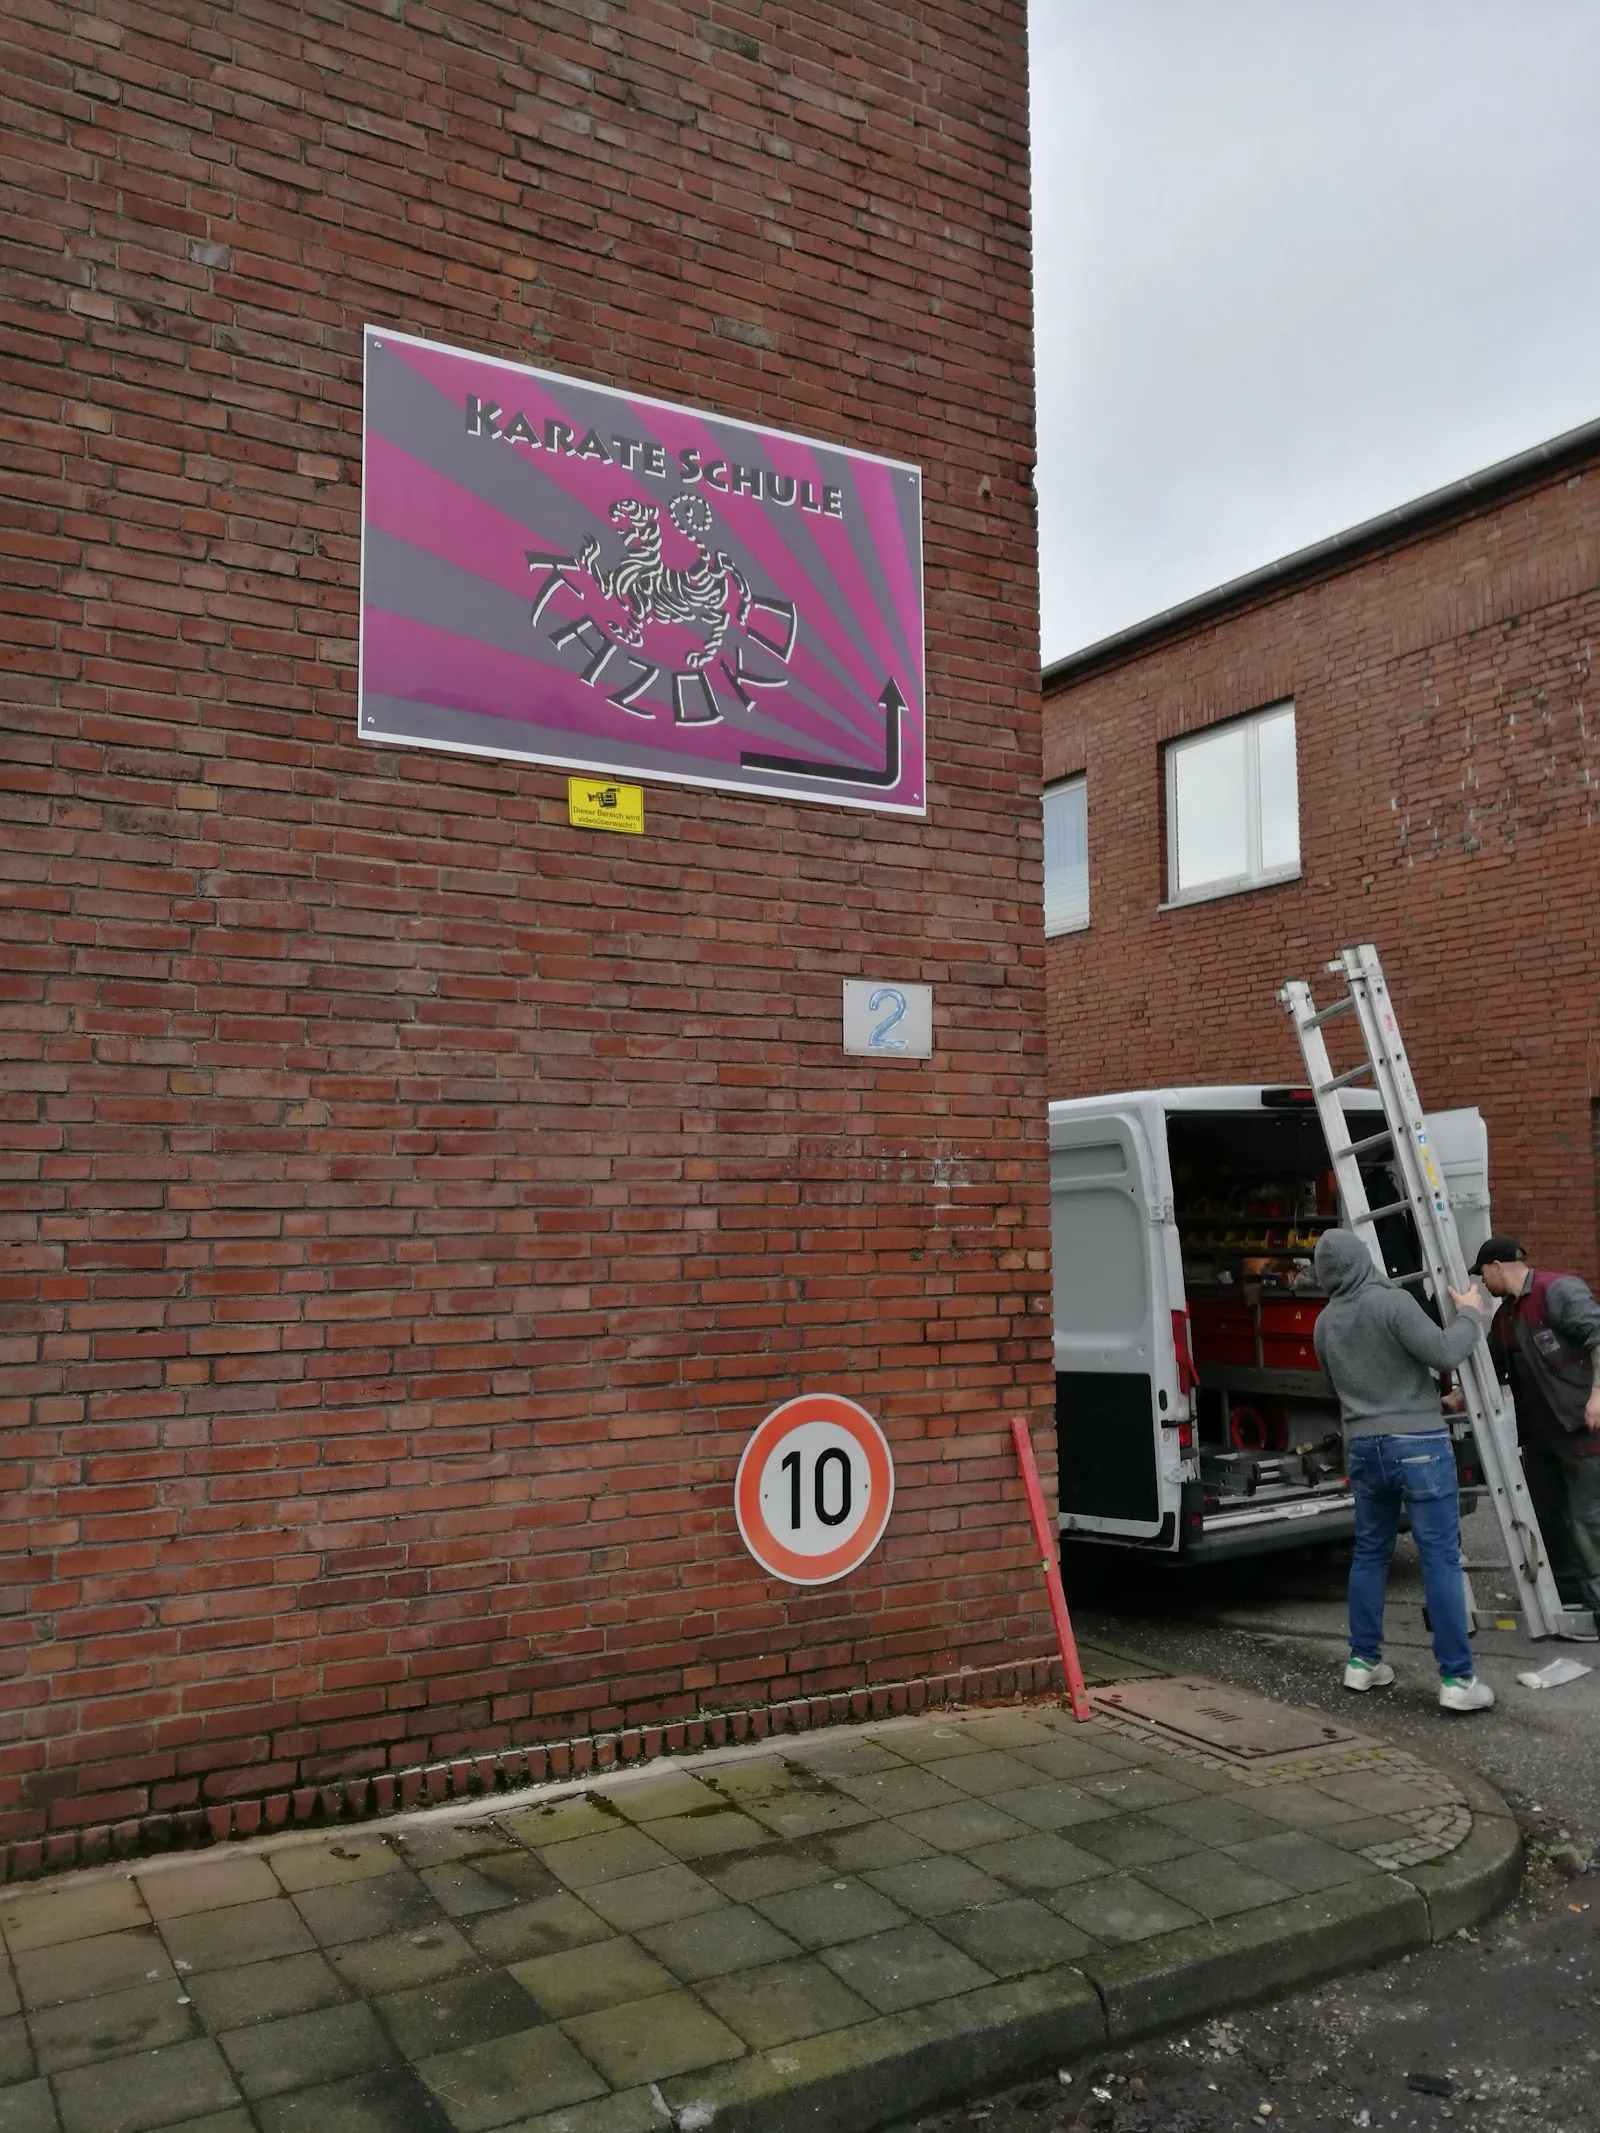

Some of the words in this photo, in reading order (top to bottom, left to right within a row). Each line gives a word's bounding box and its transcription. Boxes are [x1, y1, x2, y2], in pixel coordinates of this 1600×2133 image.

[465, 393, 666, 478] KARATE
[678, 448, 843, 519] SCHULE
[573, 806, 595, 815] Dieser
[597, 809, 624, 819] Bereich
[578, 816, 636, 829] videoüberwacht!
[868, 988, 909, 1050] 2
[782, 1447, 851, 1529] 10
